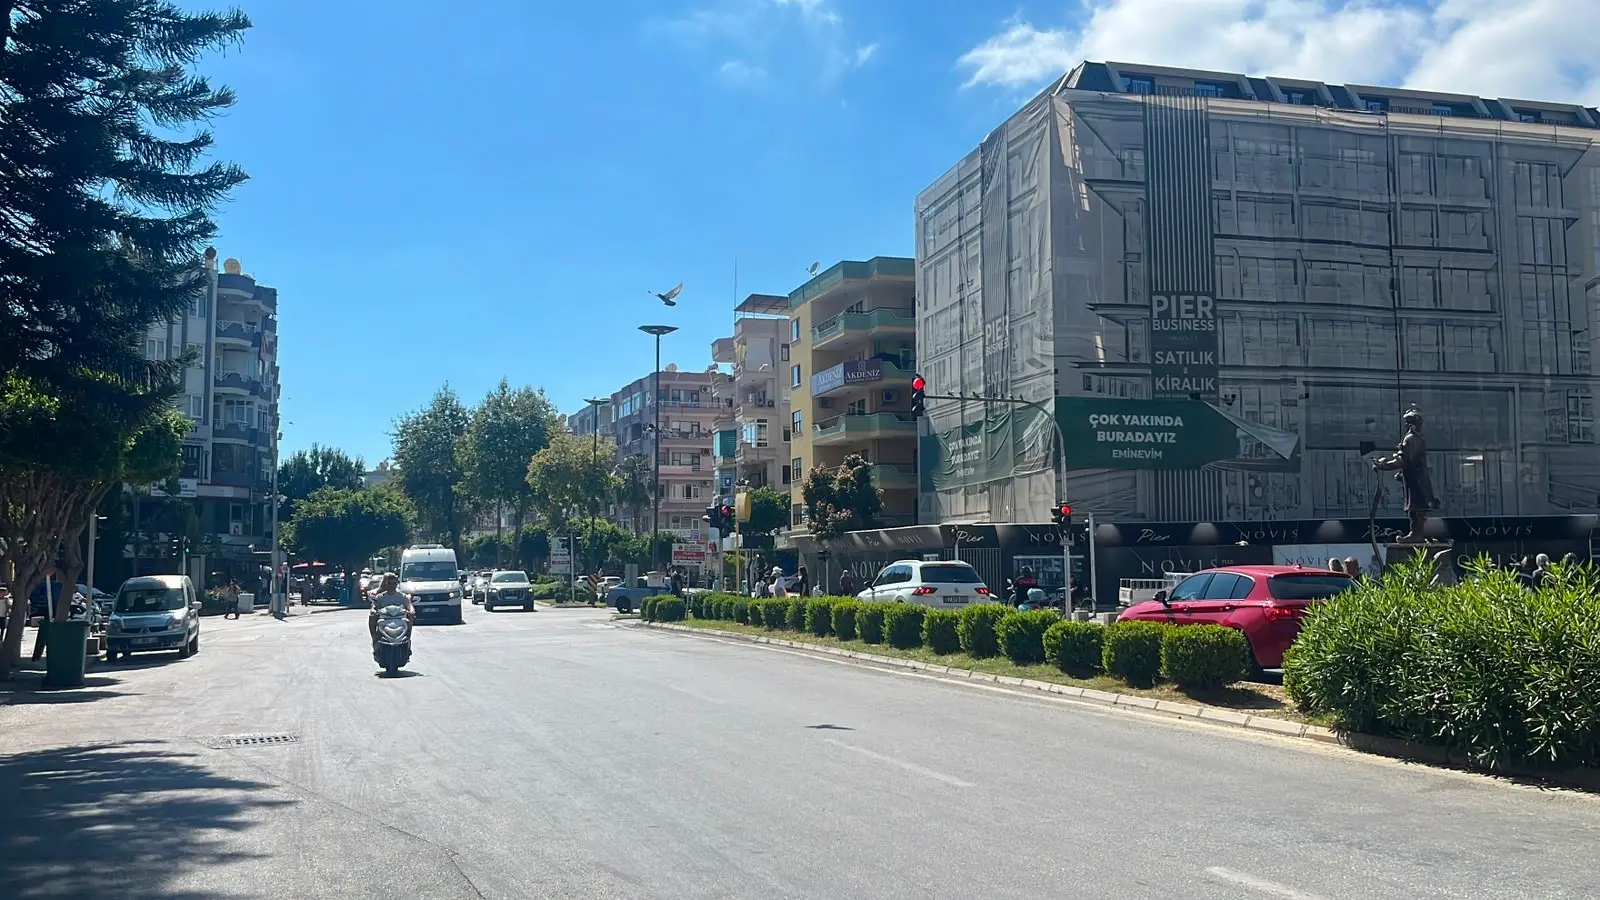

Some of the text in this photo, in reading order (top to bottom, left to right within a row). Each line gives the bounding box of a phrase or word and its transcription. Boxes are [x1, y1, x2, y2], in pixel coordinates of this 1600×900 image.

[1152, 295, 1214, 319] PIER
[1152, 319, 1215, 331] BUSINESS
[1155, 350, 1215, 365] SATILIK
[1155, 374, 1216, 391] KİRALIK
[1089, 413, 1185, 428] ÇOK YAKINDA
[1097, 431, 1177, 443] BURADAYIZ
[1112, 447, 1163, 460] EMİNEVİM
[956, 530, 985, 543] Pier
[1136, 528, 1171, 544] Pier
[1239, 528, 1298, 541] NOVIS
[1469, 525, 1532, 537] NOVIS
[1141, 559, 1217, 574] NOVIS
